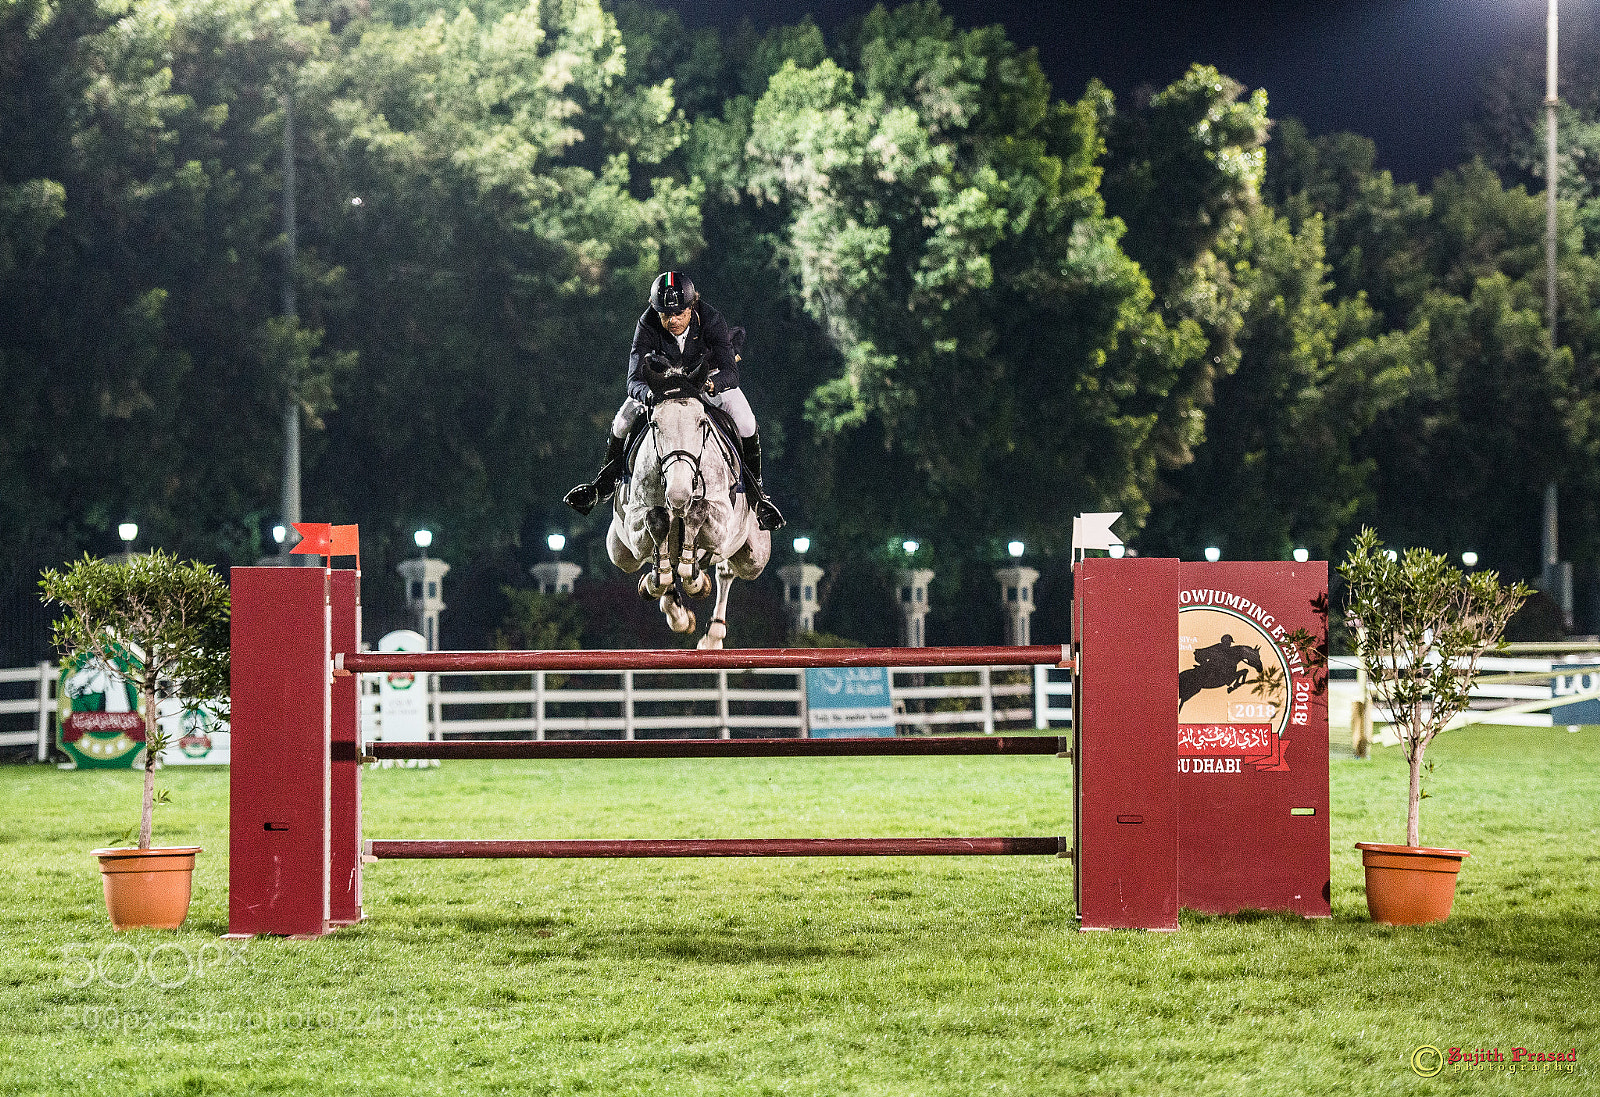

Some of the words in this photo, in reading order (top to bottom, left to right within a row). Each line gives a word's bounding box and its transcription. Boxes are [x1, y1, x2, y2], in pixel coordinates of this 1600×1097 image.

[1178, 589, 1275, 629] OWJUMPING
[1294, 682, 1310, 725] 2018
[1235, 704, 1275, 718] 2018
[1192, 758, 1242, 773] DHABI
